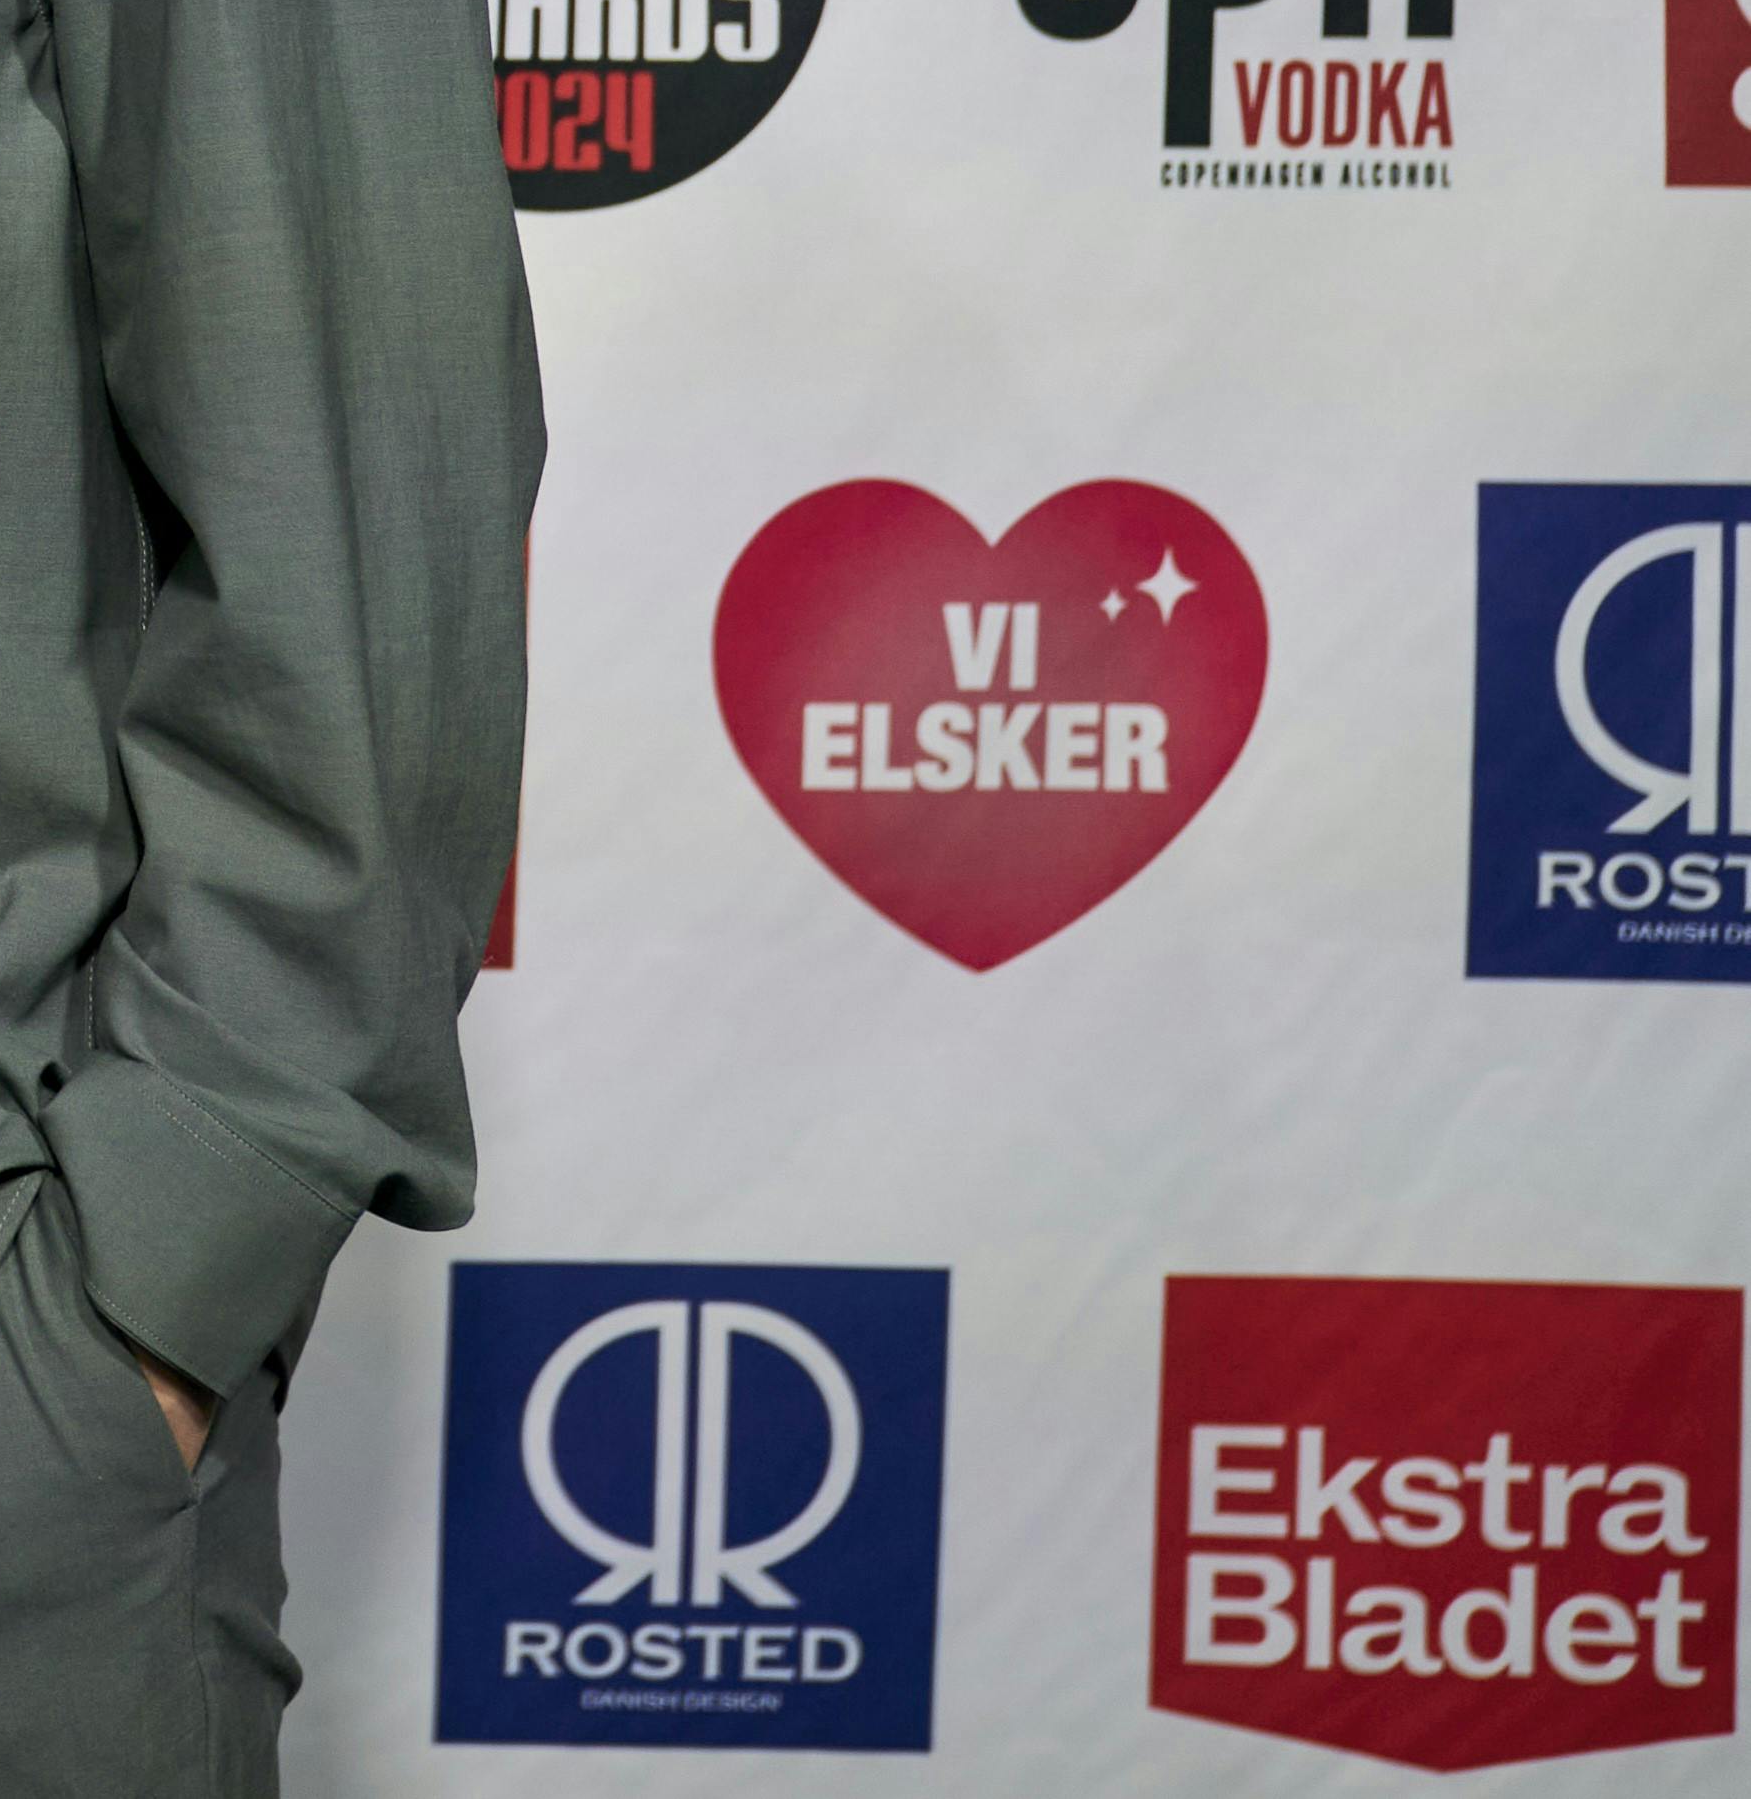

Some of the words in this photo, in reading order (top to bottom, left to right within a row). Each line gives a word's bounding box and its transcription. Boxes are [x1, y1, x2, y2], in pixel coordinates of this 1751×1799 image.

[494, 71, 655, 172] 024
[1233, 60, 1453, 148] VODKA
[1161, 160, 1324, 188] COPENHAGEN
[1341, 160, 1452, 188] ALCOHOL
[942, 602, 1040, 691] VI
[801, 703, 1168, 792] ELSKER
[1187, 1426, 1709, 1555] Ekstra
[503, 1622, 863, 1682] ROSTED
[1183, 1554, 1706, 1688] Bladet
